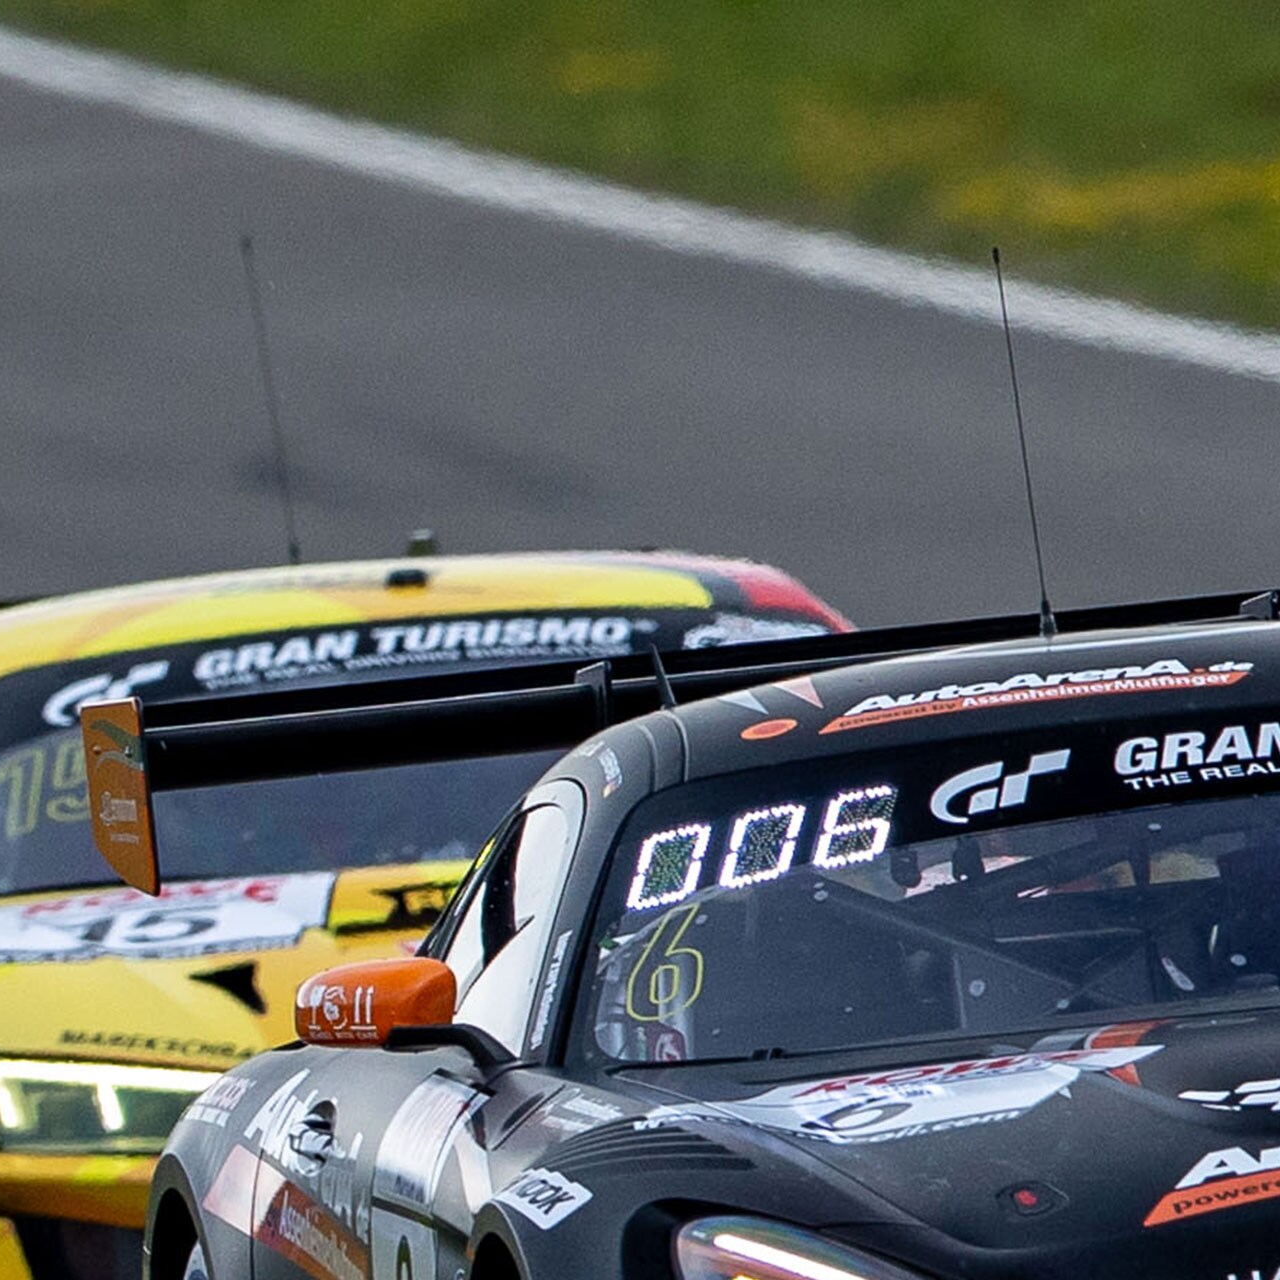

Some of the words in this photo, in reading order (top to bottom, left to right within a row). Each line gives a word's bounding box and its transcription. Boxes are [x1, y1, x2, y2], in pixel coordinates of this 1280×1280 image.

[193, 628, 359, 679] GRAN
[373, 617, 631, 655] TURISMO
[961, 672, 1231, 708] AssenheimerMulfinger
[1123, 769, 1192, 792] THE
[626, 783, 896, 911] 006
[625, 902, 704, 1022] 6
